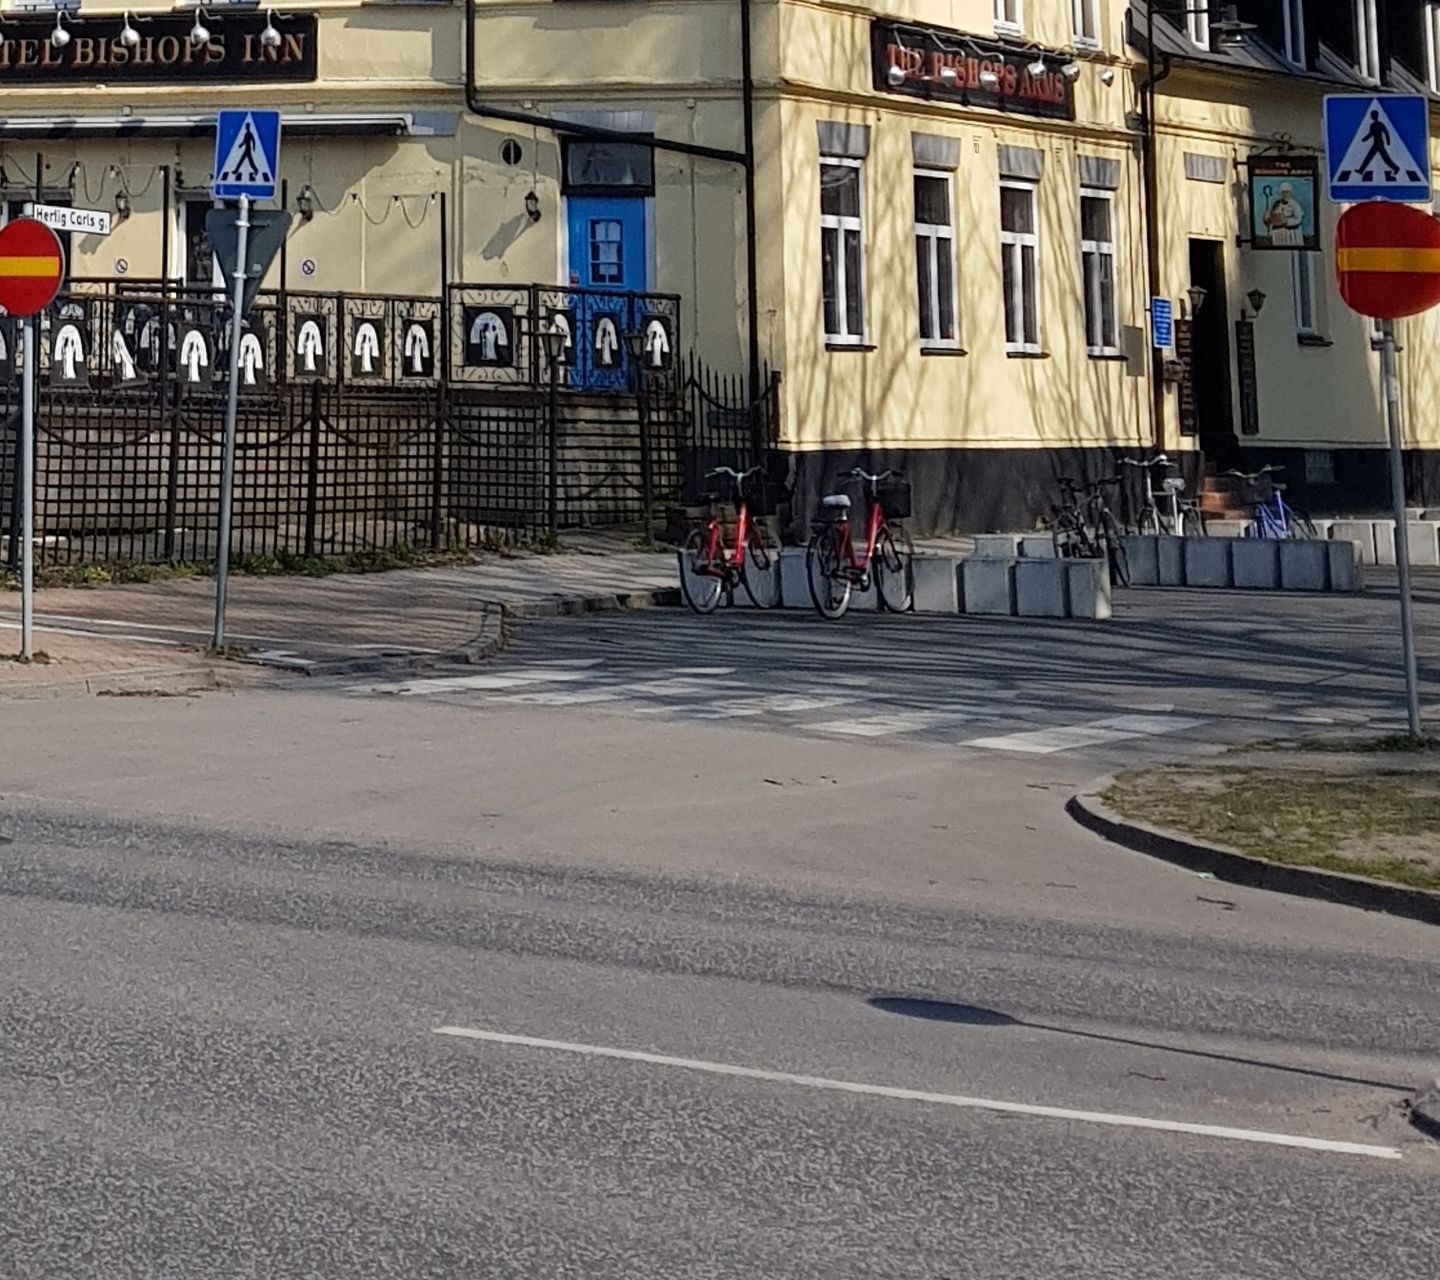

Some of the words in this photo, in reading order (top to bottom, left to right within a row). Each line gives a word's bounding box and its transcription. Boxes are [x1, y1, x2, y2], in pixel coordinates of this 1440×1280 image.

[73, 35, 226, 67] BISHOPS
[242, 33, 306, 63] INN
[1019, 69, 1065, 104] ARMS
[70, 211, 95, 227] Carls
